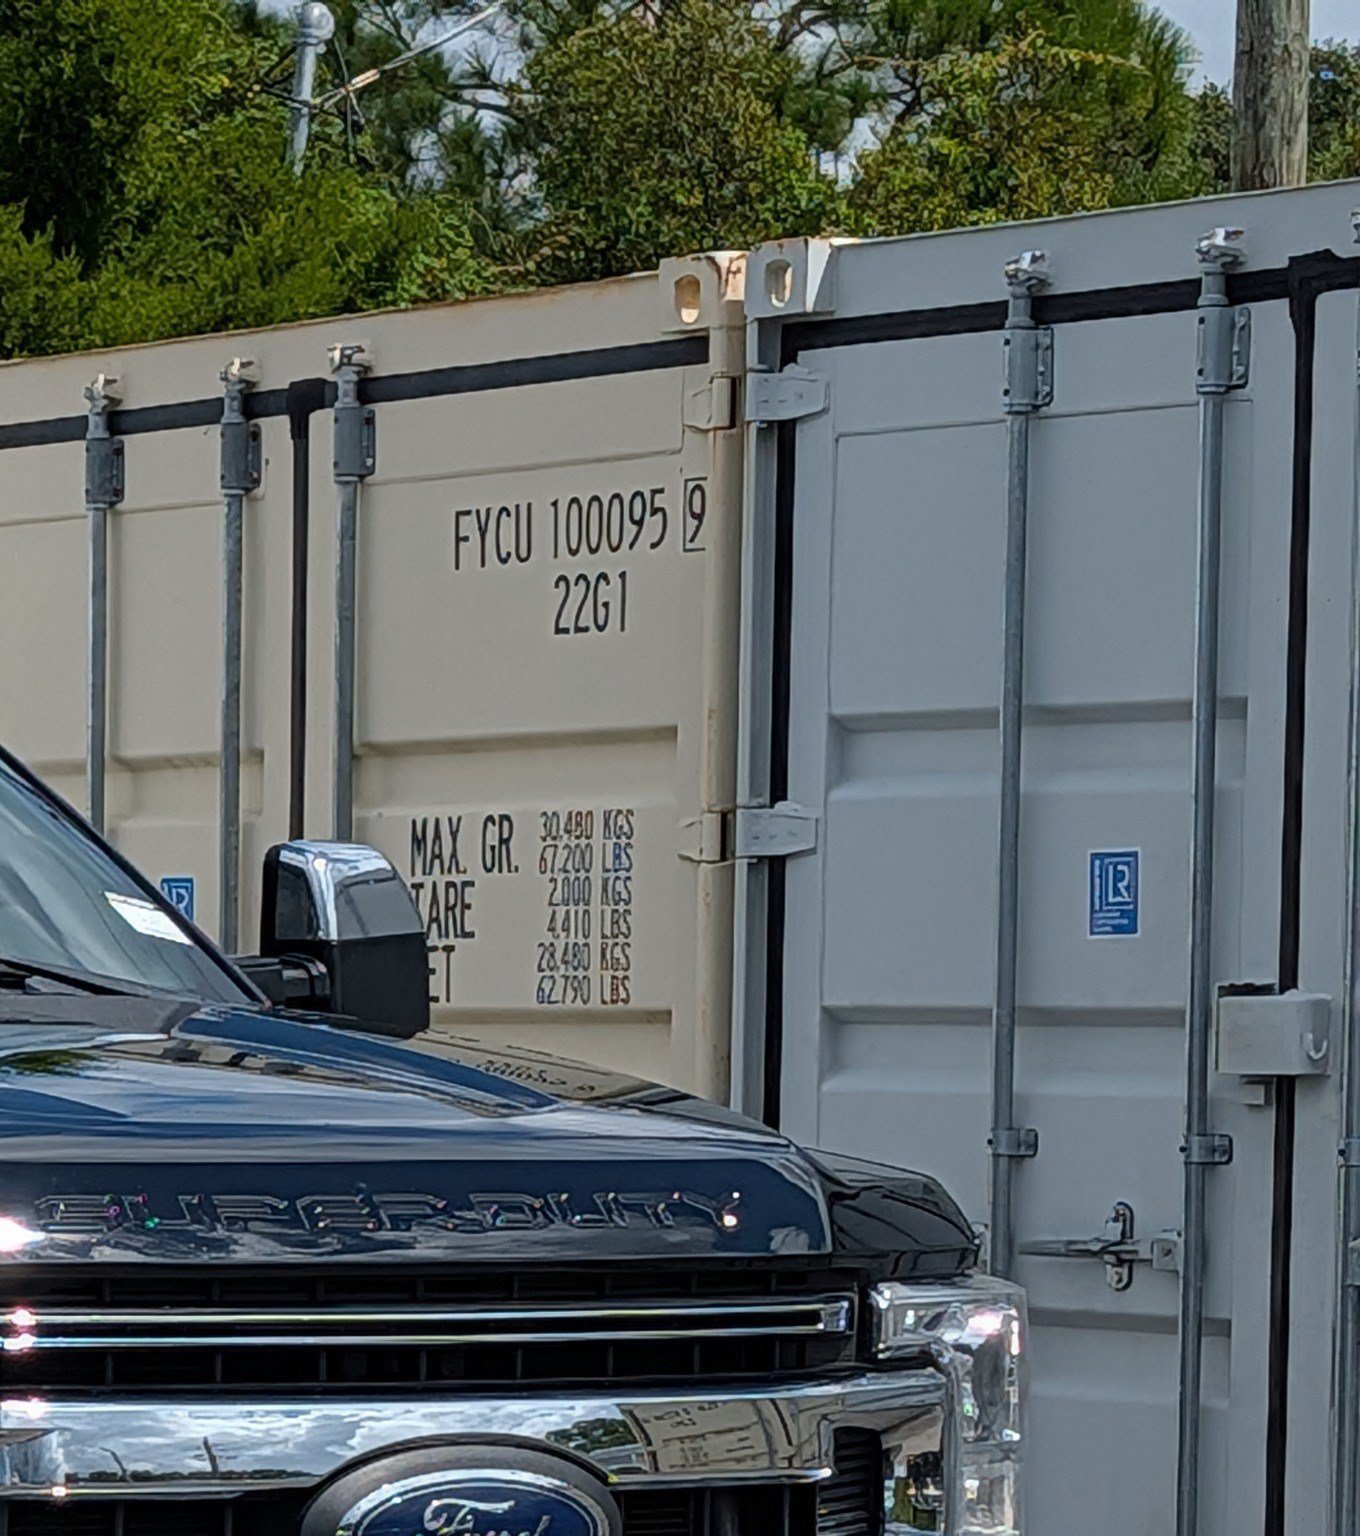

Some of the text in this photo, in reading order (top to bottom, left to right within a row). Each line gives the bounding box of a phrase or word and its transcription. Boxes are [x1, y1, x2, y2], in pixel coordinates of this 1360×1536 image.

[454, 483, 706, 570] FYCU 100095 9
[553, 569, 627, 636] 22G1
[410, 814, 468, 878] MAX.
[482, 813, 520, 874] GR.
[602, 808, 635, 840] KGS
[601, 841, 634, 873] LBS
[410, 879, 476, 940] TARE
[600, 875, 633, 907] KGS
[600, 908, 632, 940] LBS
[600, 941, 631, 972] KGS
[600, 974, 631, 1005] LBS
